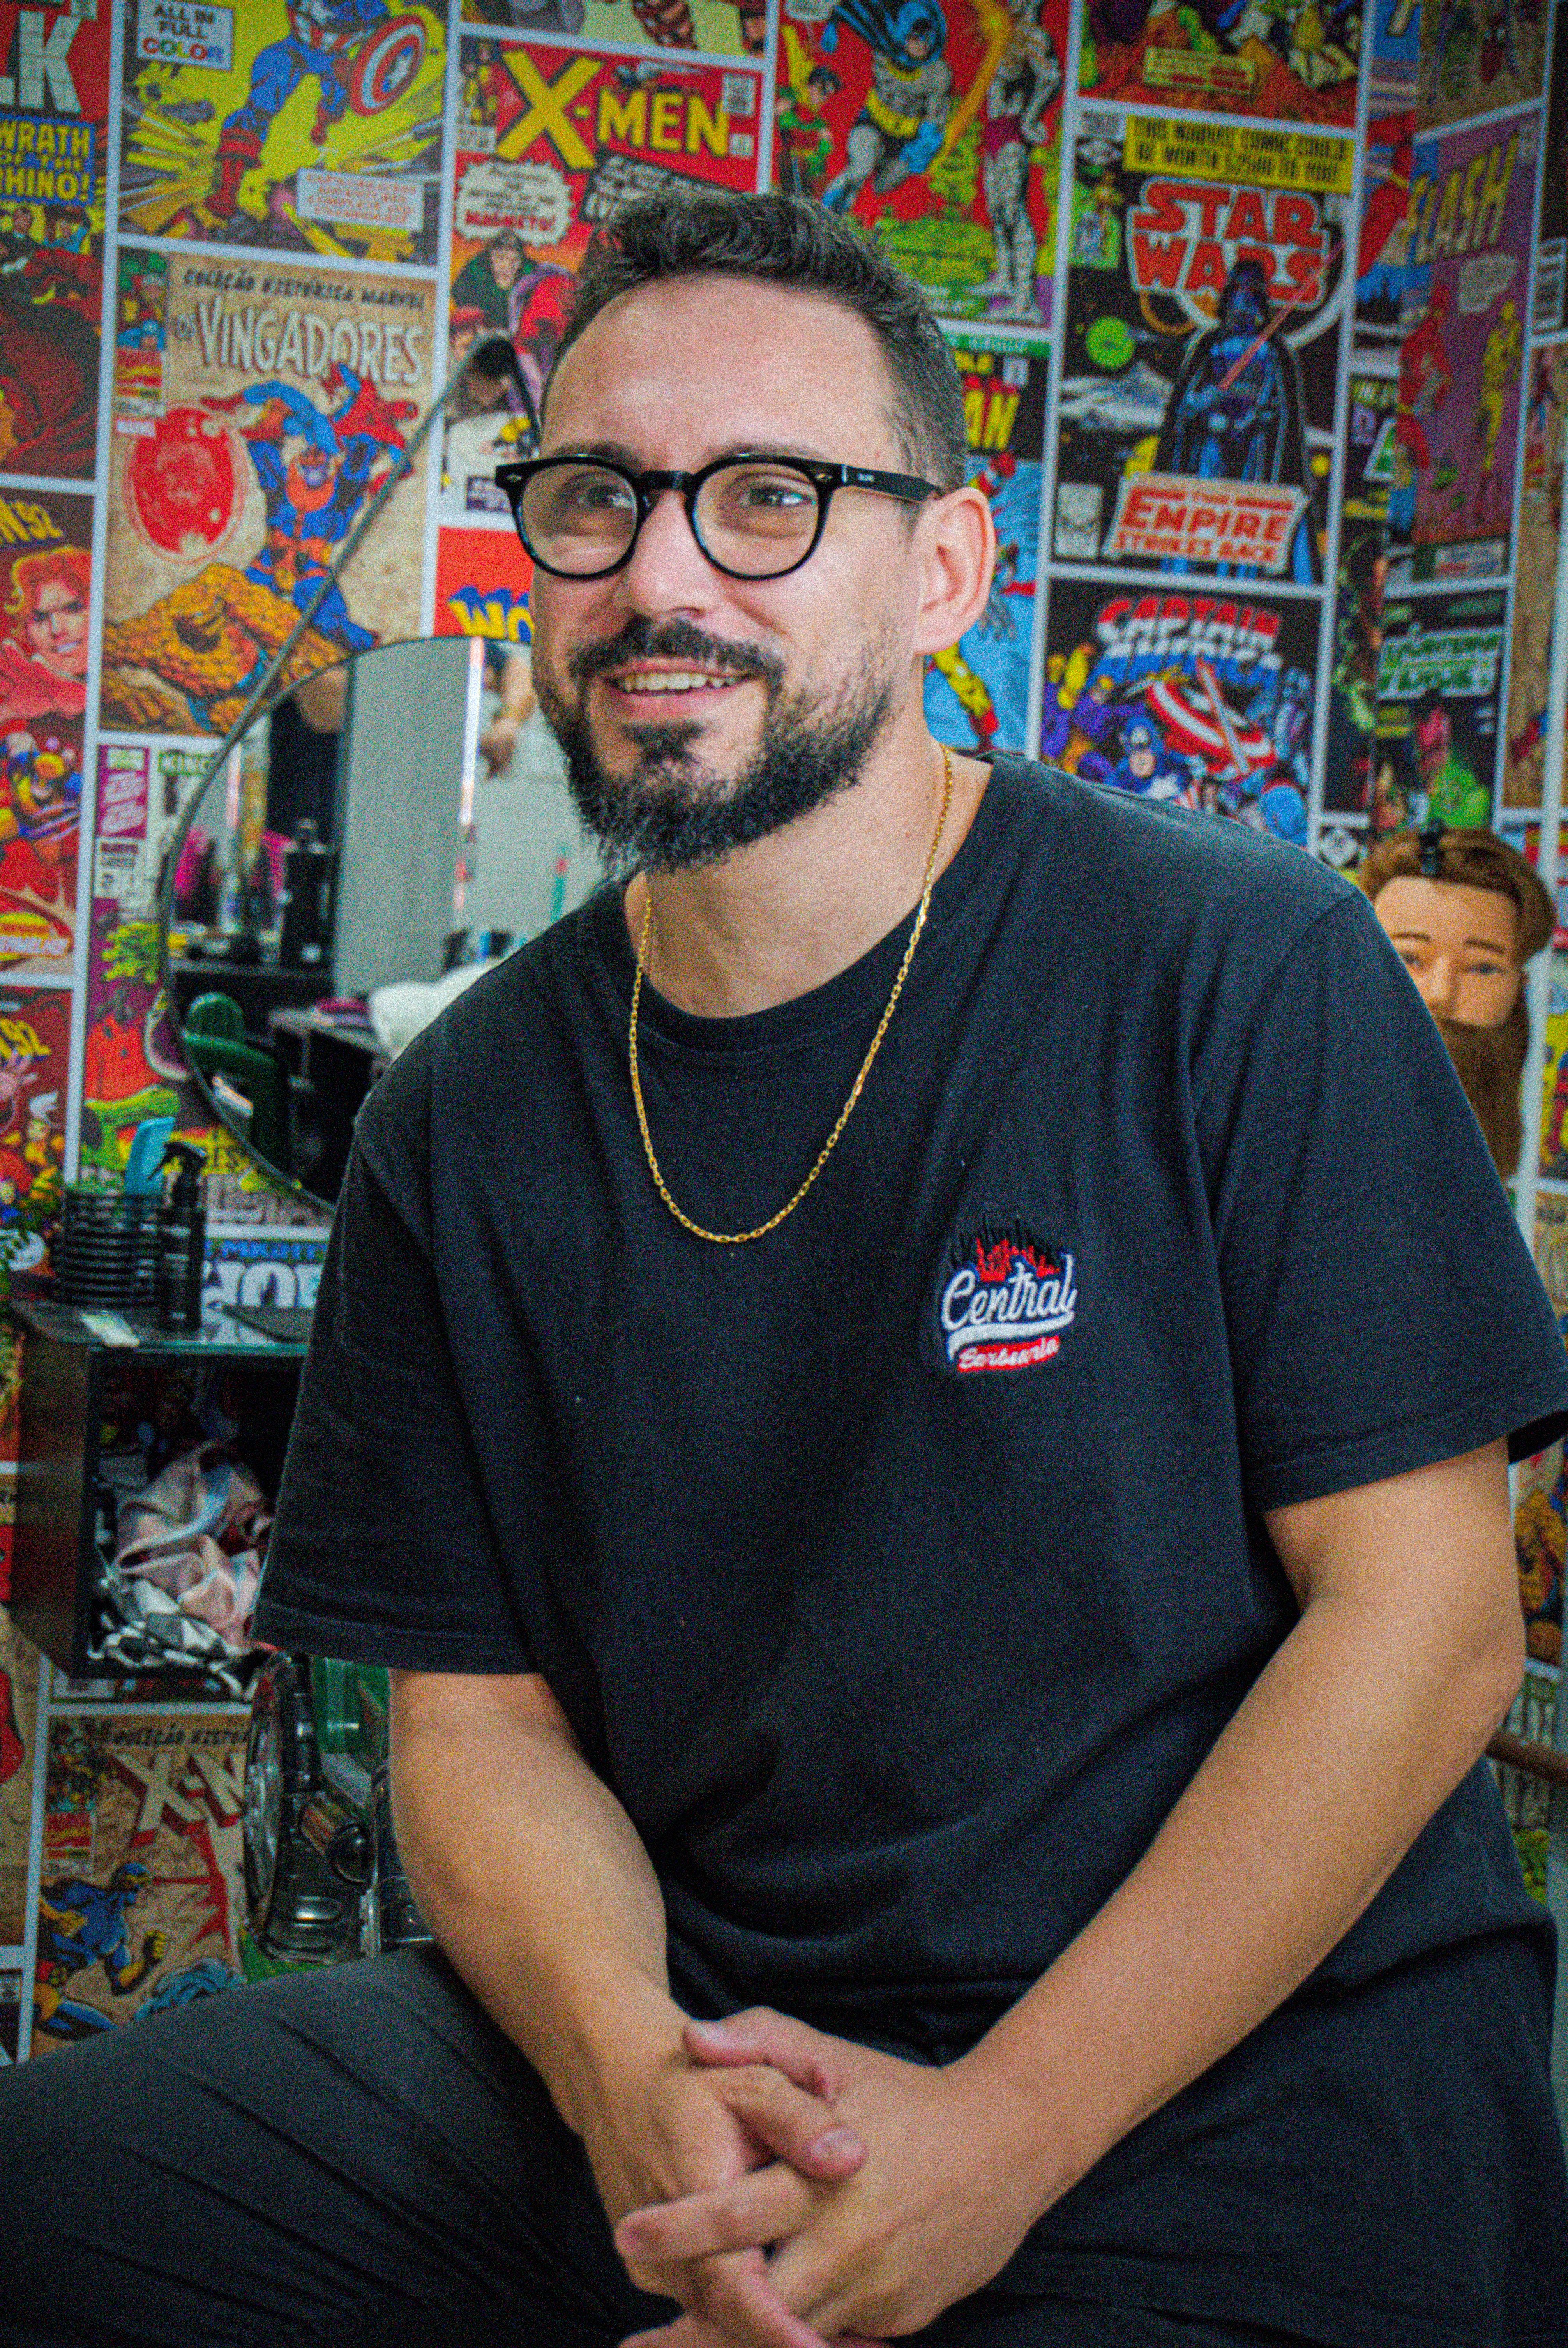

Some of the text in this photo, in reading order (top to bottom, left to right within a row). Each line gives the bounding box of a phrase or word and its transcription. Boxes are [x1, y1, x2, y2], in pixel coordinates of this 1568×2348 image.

[154, 4, 216, 25] ALL IN
[159, 19, 208, 39] FULL
[0, 10, 82, 114] K
[142, 37, 224, 63] COLOR
[496, 49, 730, 171] X-MEN
[0, 166, 90, 203] HINO!
[1132, 183, 1323, 249] STAR
[183, 267, 256, 292] COLEÇÃO
[361, 287, 426, 310] MARVEL
[199, 295, 426, 383] VINGADORES
[1121, 487, 1294, 542] EMPIRE
[1114, 531, 1277, 563] STRIKES BACK
[1096, 597, 1283, 651] CAPTAIN
[941, 1253, 1078, 1331] Central
